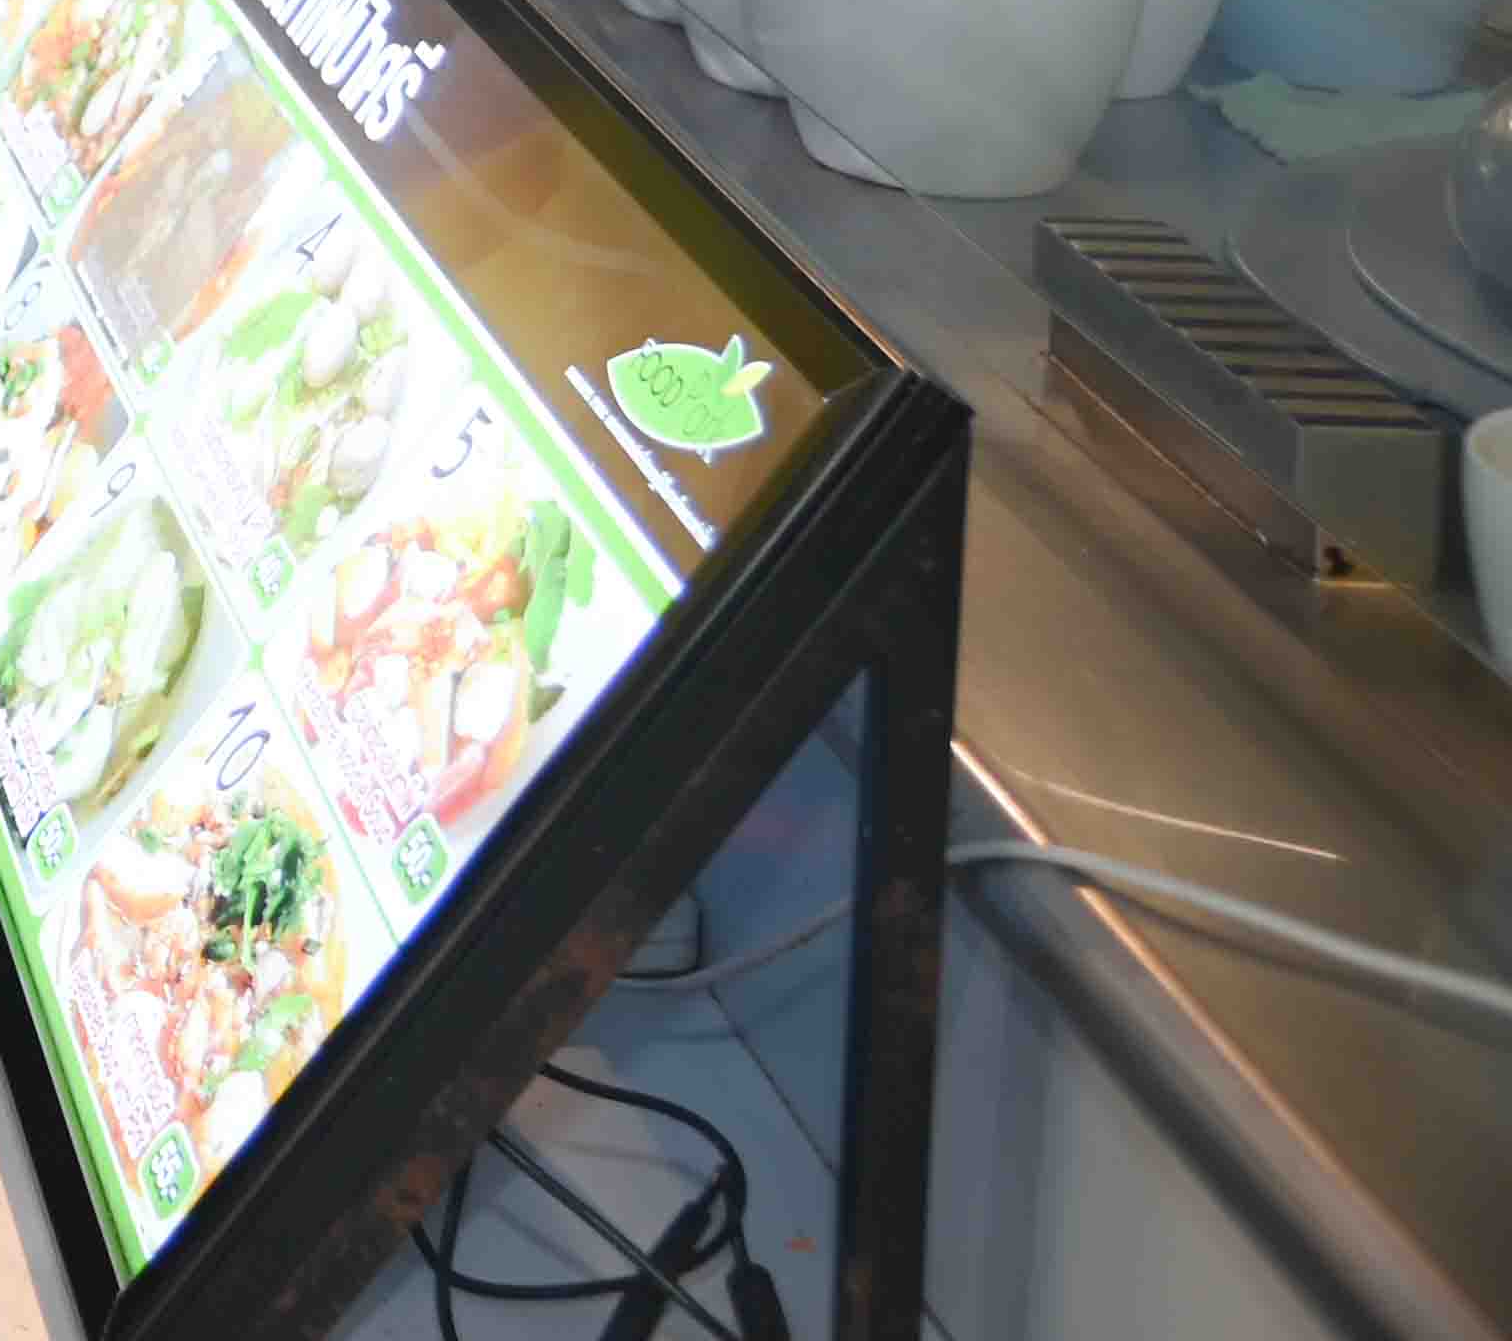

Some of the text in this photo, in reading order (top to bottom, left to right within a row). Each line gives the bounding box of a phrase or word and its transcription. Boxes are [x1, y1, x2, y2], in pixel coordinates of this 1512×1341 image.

[295, 212, 344, 275] 4
[430, 406, 494, 479] 5
[89, 462, 138, 518] 9
[204, 701, 272, 792] 10
